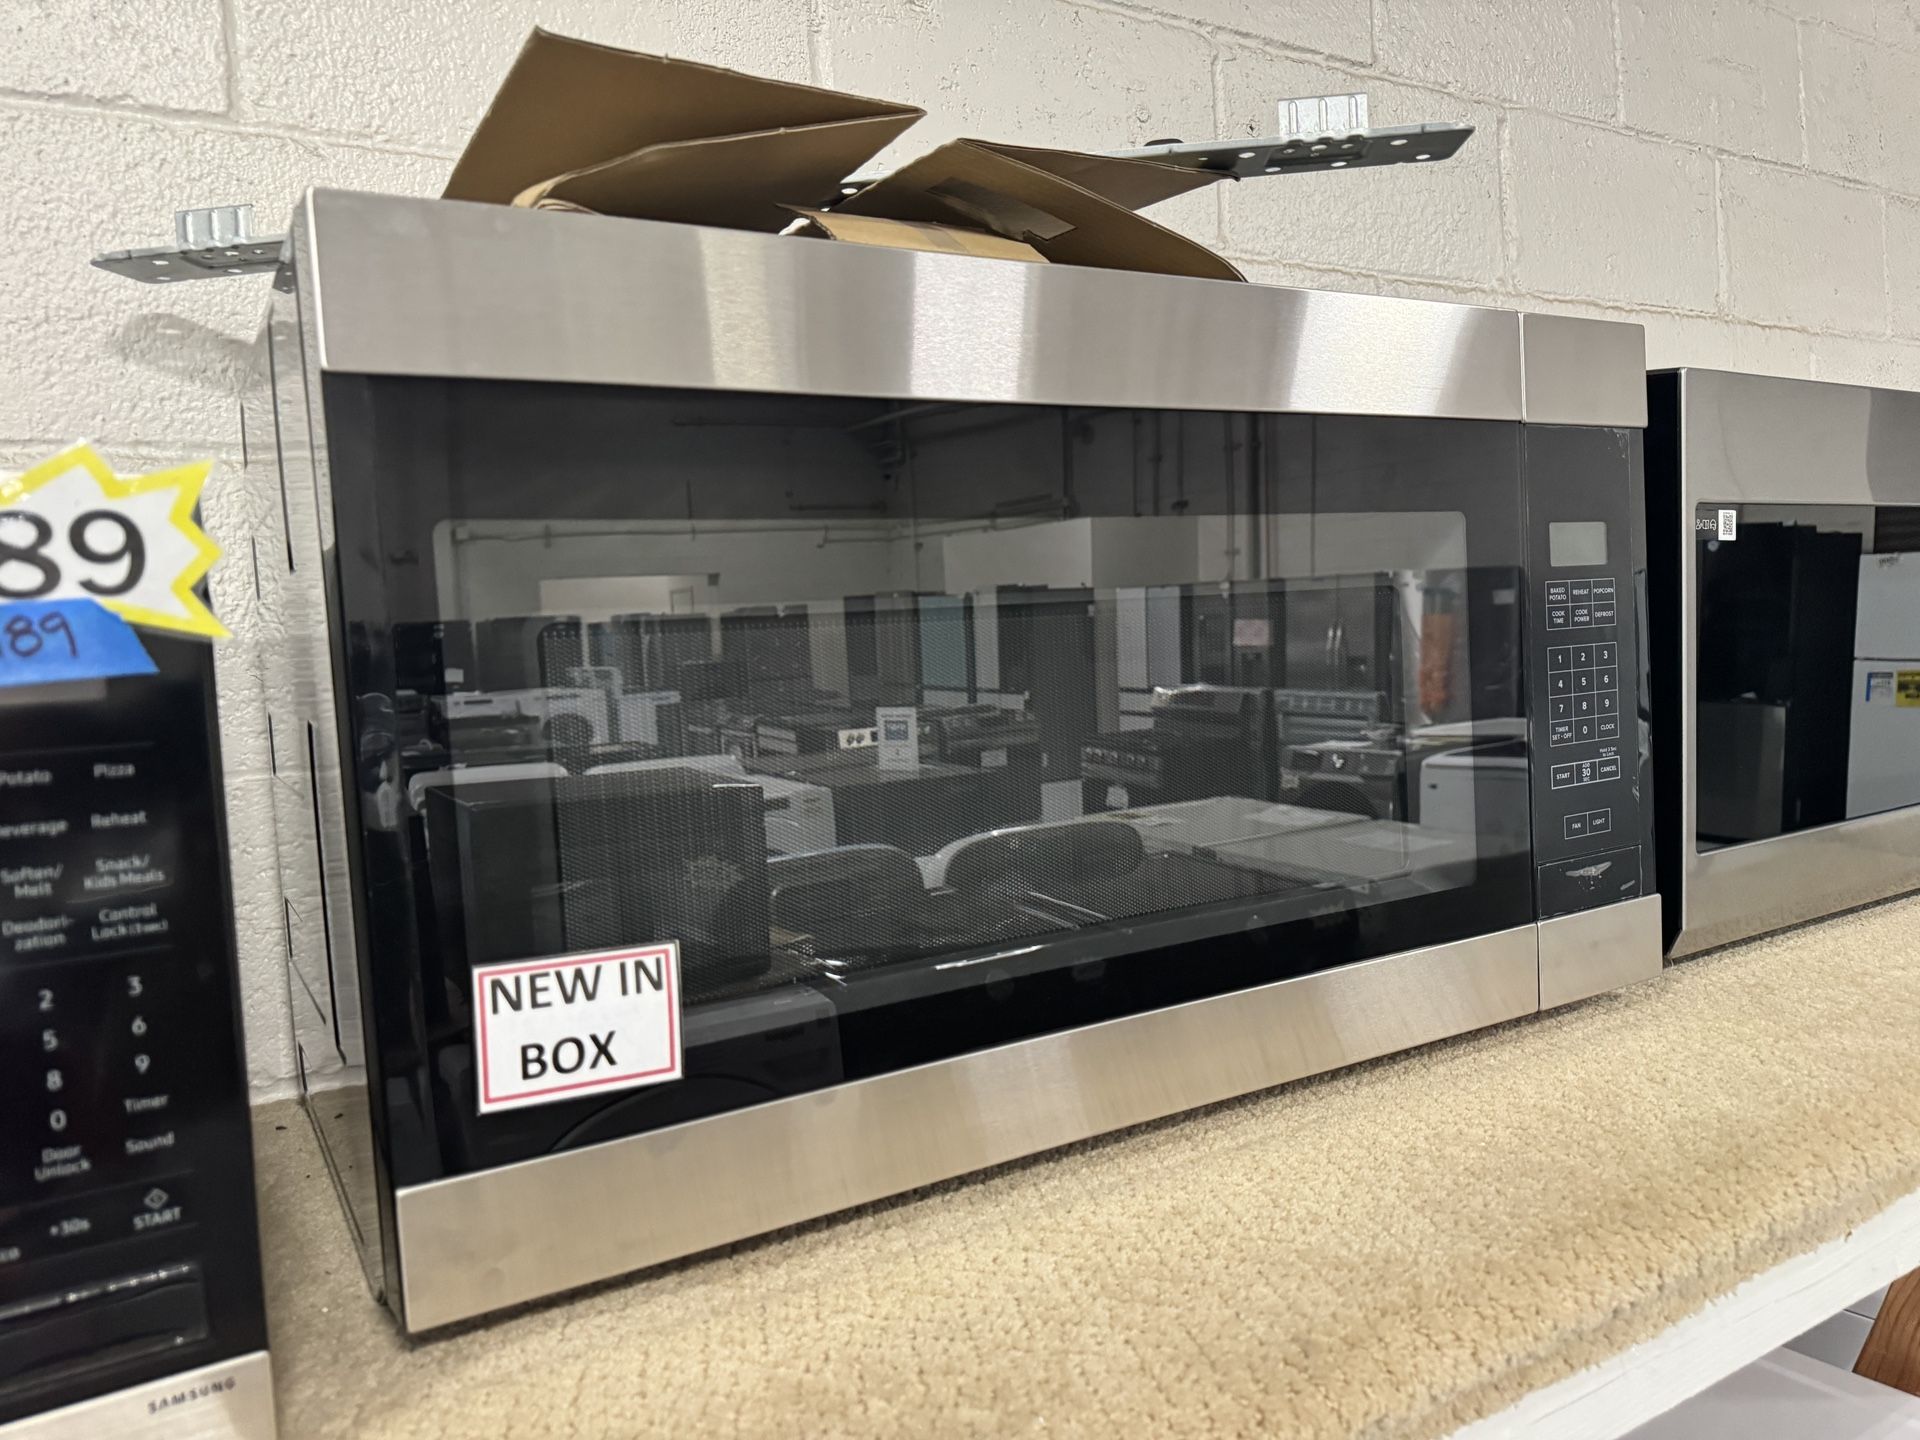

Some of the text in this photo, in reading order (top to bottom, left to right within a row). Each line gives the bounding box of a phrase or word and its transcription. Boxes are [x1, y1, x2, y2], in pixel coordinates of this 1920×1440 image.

[0, 510, 145, 597] 89
[0, 610, 79, 659] 89
[1580, 652, 1586, 661] 2
[1603, 650, 1608, 659] 3
[1558, 679, 1563, 688] 4
[1581, 677, 1586, 686] 5
[1603, 674, 1609, 683] 6
[1559, 704, 1564, 713] 7
[1582, 701, 1587, 710] 8
[1604, 698, 1610, 707] 9
[1555, 725, 1569, 733] TIMER
[1582, 725, 1588, 734] 0
[1600, 723, 1615, 731] CLOCK
[1556, 772, 1570, 780] START
[1582, 768, 1591, 777] 30
[91, 810, 147, 828] Reheat
[1592, 818, 1605, 826] LIGHT
[0, 820, 68, 839] everage
[1571, 822, 1582, 830] FAN
[127, 975, 143, 996] 3
[490, 957, 663, 1015] NEW IN
[38, 989, 54, 1011] 2
[131, 1016, 147, 1036] 6
[42, 1029, 59, 1050] 5
[520, 1030, 618, 1081] BOX
[134, 1053, 150, 1074] 9
[46, 1068, 63, 1092] 8
[49, 1109, 67, 1131] 0
[133, 1206, 182, 1230] START
[147, 1376, 236, 1415] SAMSUNG
